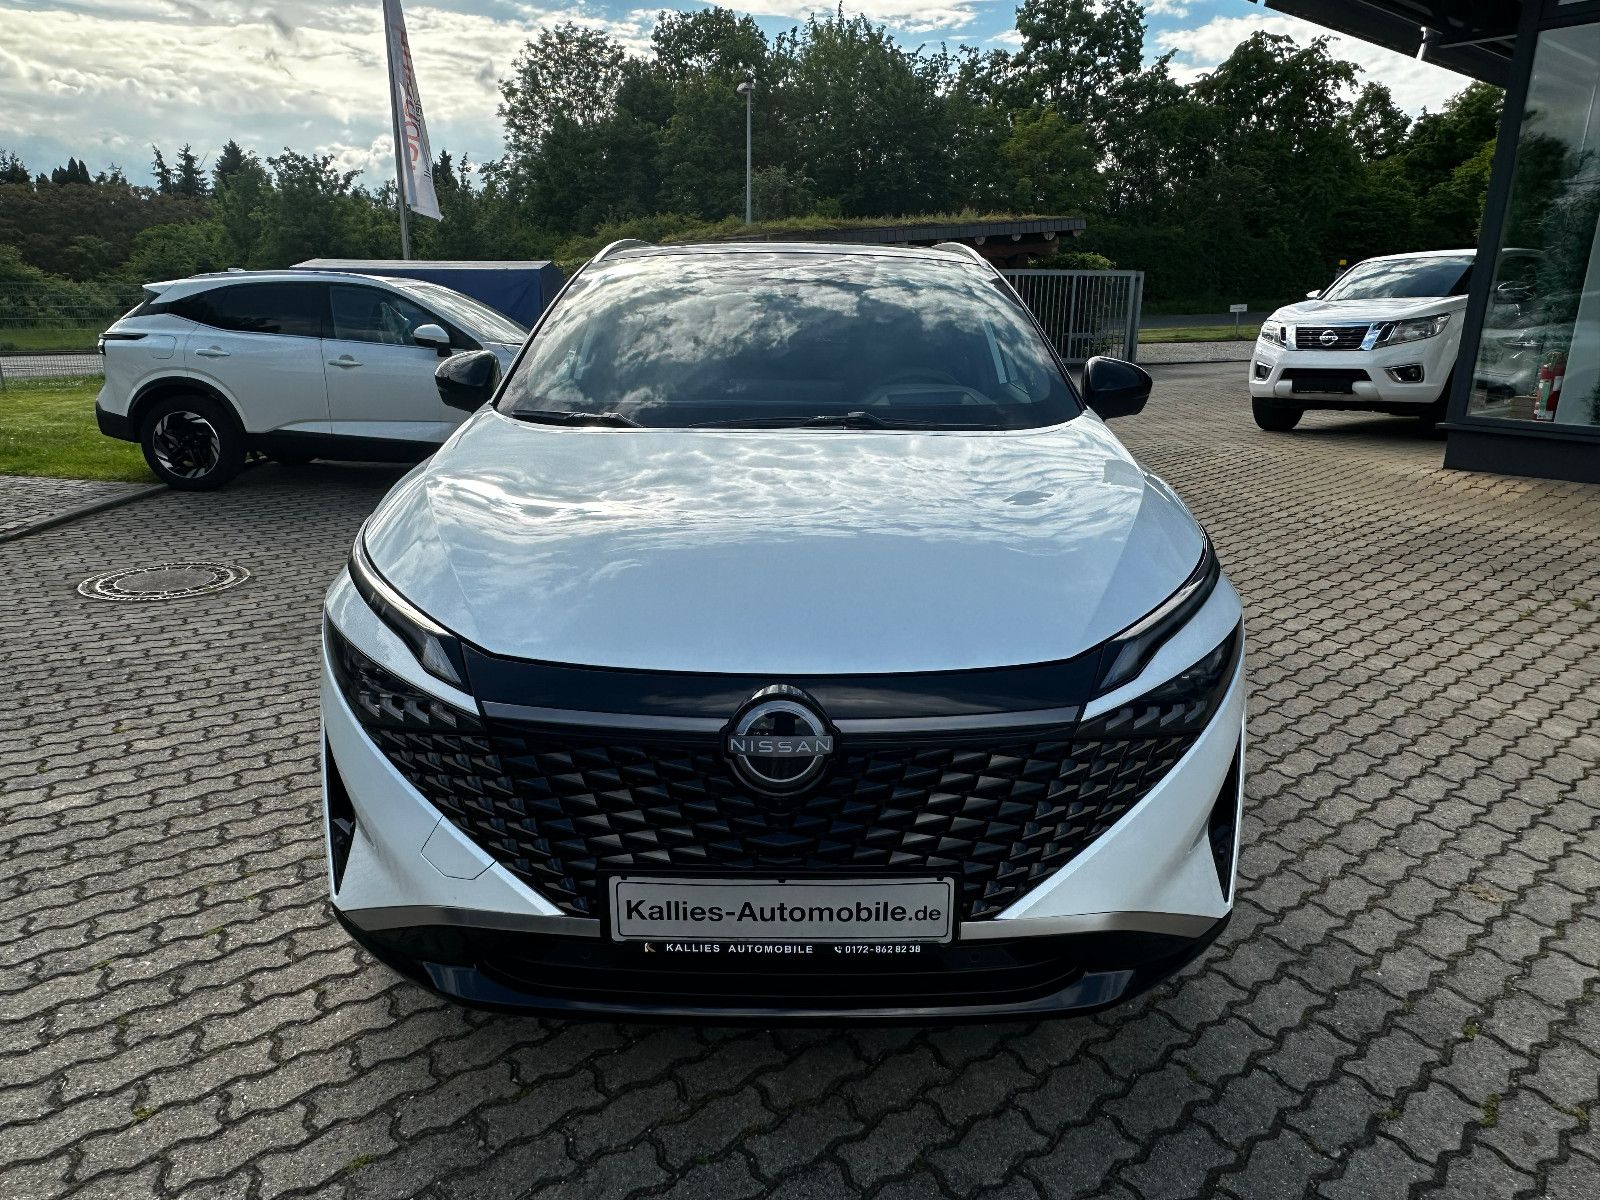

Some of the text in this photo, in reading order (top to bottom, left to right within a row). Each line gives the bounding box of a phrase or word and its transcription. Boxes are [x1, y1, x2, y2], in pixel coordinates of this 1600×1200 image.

[730, 738, 831, 753] NISSAN
[626, 899, 942, 923] Kallies-Automobile.de
[666, 943, 720, 953] KALLIES
[728, 944, 813, 954] AUTOMOBILE
